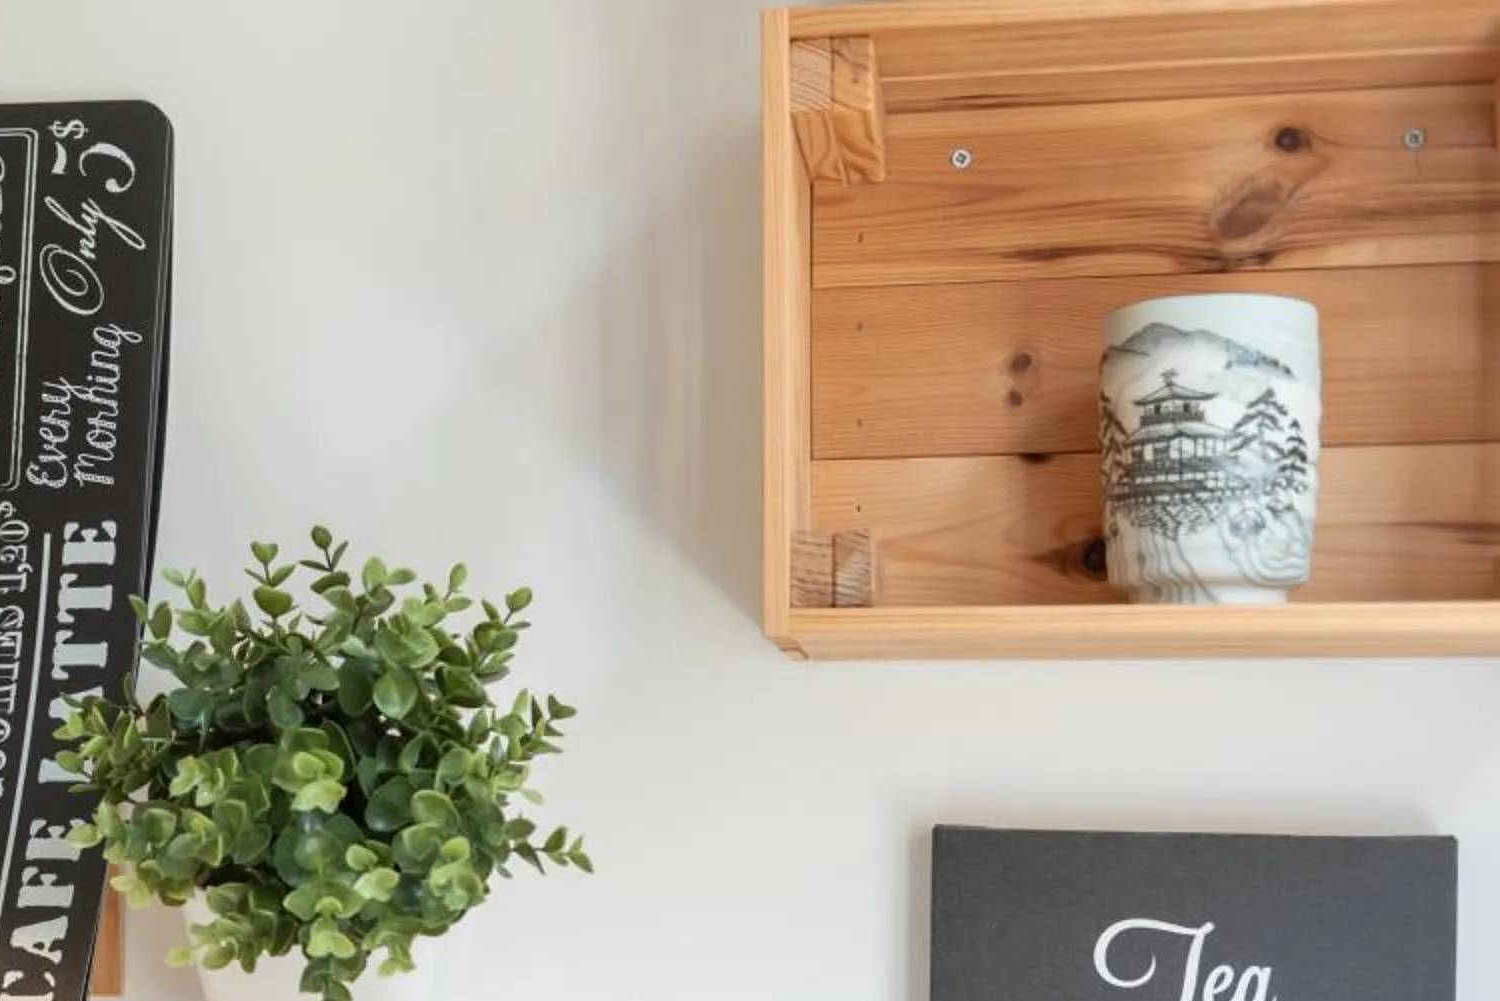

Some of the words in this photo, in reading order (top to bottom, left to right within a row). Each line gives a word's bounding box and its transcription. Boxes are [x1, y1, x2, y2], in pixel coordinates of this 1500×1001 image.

[40, 196, 147, 316] Only
[26, 377, 91, 489] Every
[75, 324, 143, 485] Morning
